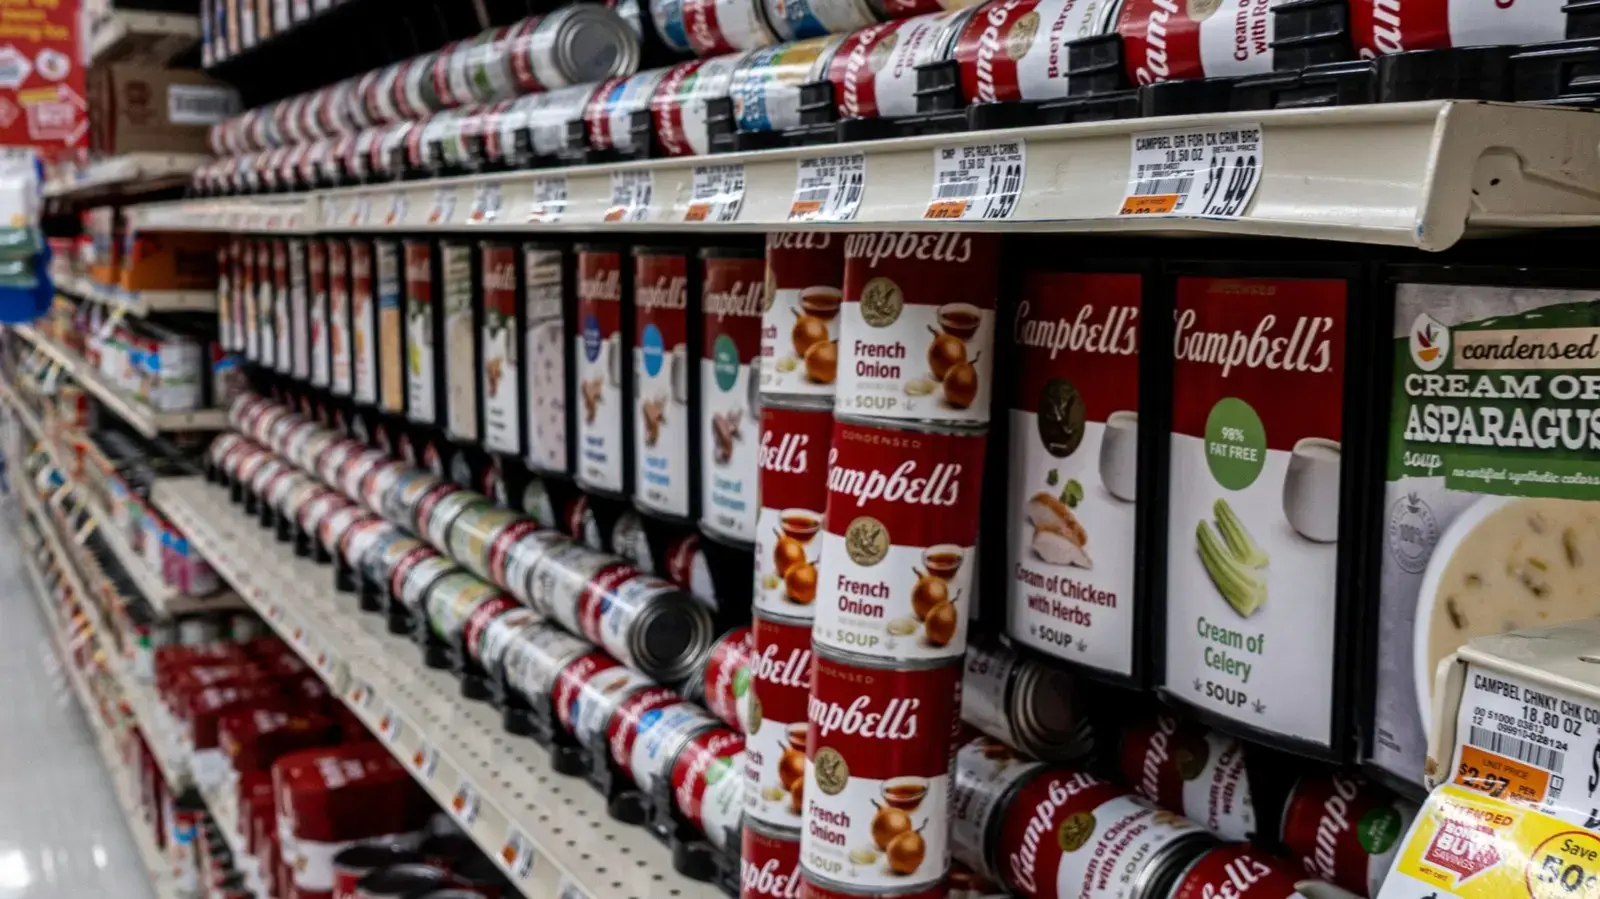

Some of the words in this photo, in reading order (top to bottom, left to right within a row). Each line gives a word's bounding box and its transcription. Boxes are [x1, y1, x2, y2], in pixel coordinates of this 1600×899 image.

[1252, 0, 1268, 17] Ro
[1234, 10, 1249, 62] Cream
[1250, 18, 1269, 56] with
[1048, 36, 1060, 79] Beef
[1136, 136, 1172, 151] CAMPBEL
[1174, 135, 1186, 148] GR
[1188, 133, 1204, 147] FOR
[1206, 132, 1217, 145] CK
[1219, 130, 1239, 145] CRM
[1212, 145, 1236, 153] RETAIL
[1237, 143, 1258, 151] PRICE
[1165, 149, 1190, 162] 10.50
[1191, 148, 1204, 161] OZ
[1201, 155, 1257, 215] $1.99
[853, 339, 907, 360] French
[1173, 308, 1334, 378] Campbell's
[1461, 333, 1600, 360] condensed
[855, 361, 902, 384] Onion
[1404, 373, 1542, 400] CREAM
[855, 394, 898, 411] SOUP
[1221, 425, 1245, 442] 98%
[1209, 441, 1228, 457] FAT
[1228, 445, 1259, 462] FREE
[1402, 450, 1443, 477] soup
[1508, 469, 1560, 486] synthetic
[837, 574, 890, 600] French
[1014, 562, 1045, 589] Cream
[1046, 575, 1059, 594] of
[1060, 577, 1117, 609] Chicken
[837, 596, 884, 618] Onion
[1027, 594, 1050, 616] with
[1052, 599, 1092, 628] Herbs
[836, 629, 880, 648] SOUP
[1039, 624, 1073, 648] SOUP
[1196, 615, 1243, 650] Cream
[1246, 633, 1265, 656] of
[1203, 646, 1252, 684] Celery
[1205, 680, 1248, 708] SOUP
[1473, 674, 1522, 701] CAMPBEL
[1523, 688, 1558, 712] CHNKY
[1559, 699, 1582, 720] CHK
[1583, 706, 1600, 726] CO
[1472, 715, 1484, 727] 12
[1473, 706, 1487, 718] 00
[1487, 710, 1516, 725] 51000
[1521, 705, 1560, 730] 18.80
[1563, 717, 1583, 737] OZ
[1459, 763, 1510, 798] $2.97
[1519, 785, 1537, 798] PER
[1094, 840, 1108, 857] of
[1097, 857, 1117, 891] with
[1109, 822, 1149, 858] Herbs
[1560, 838, 1600, 862] Save
[1120, 842, 1150, 884] SOUP
